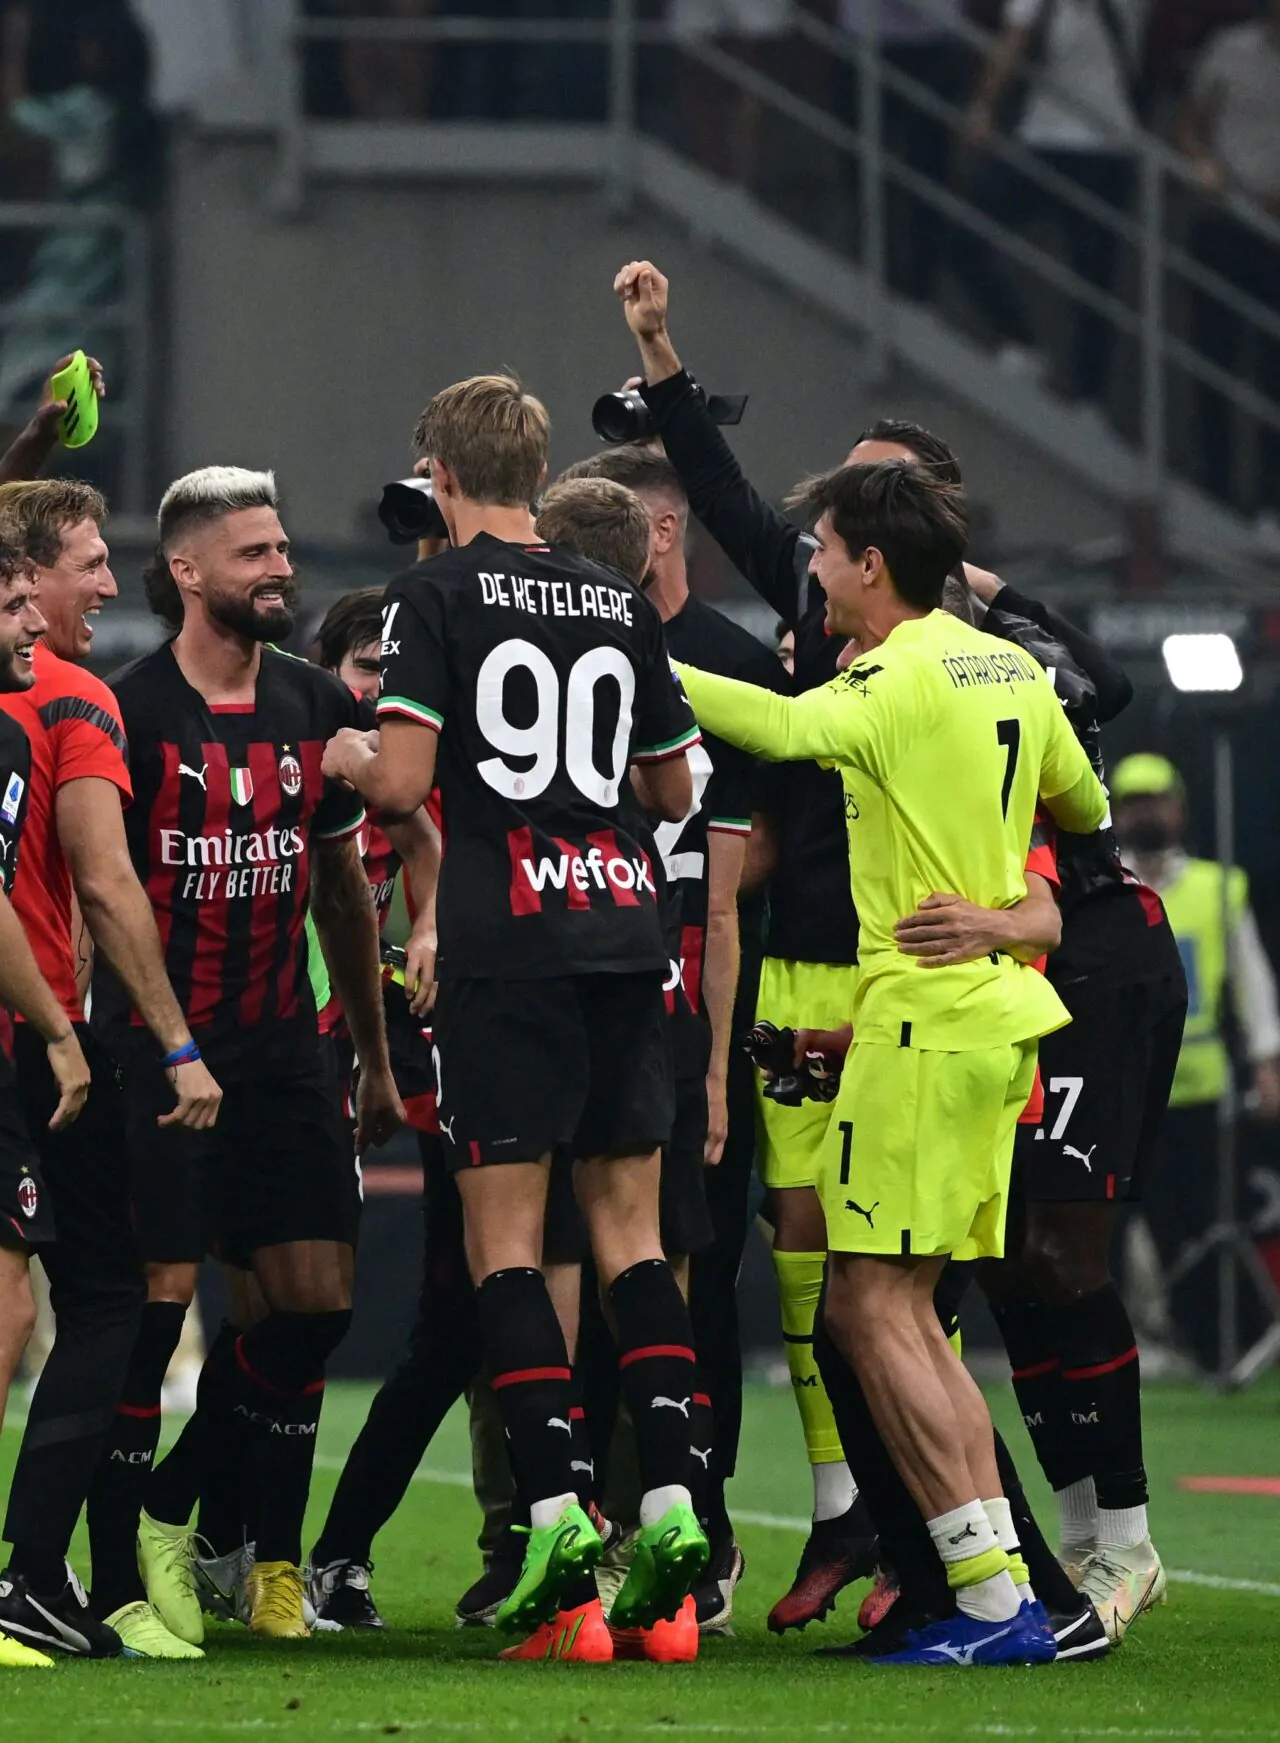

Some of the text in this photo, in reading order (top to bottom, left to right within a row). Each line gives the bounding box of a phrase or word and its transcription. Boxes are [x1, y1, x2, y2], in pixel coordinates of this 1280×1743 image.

[478, 572, 633, 627] DE KETELAERE
[476, 638, 636, 809] 90
[996, 719, 1022, 823] 1
[160, 825, 305, 866] Emirates
[182, 863, 293, 900] FLY BETTER
[522, 848, 657, 893] wefox
[838, 1120, 855, 1185] 1
[269, 1422, 317, 1435] ACM
[110, 1449, 152, 1464] ACM
